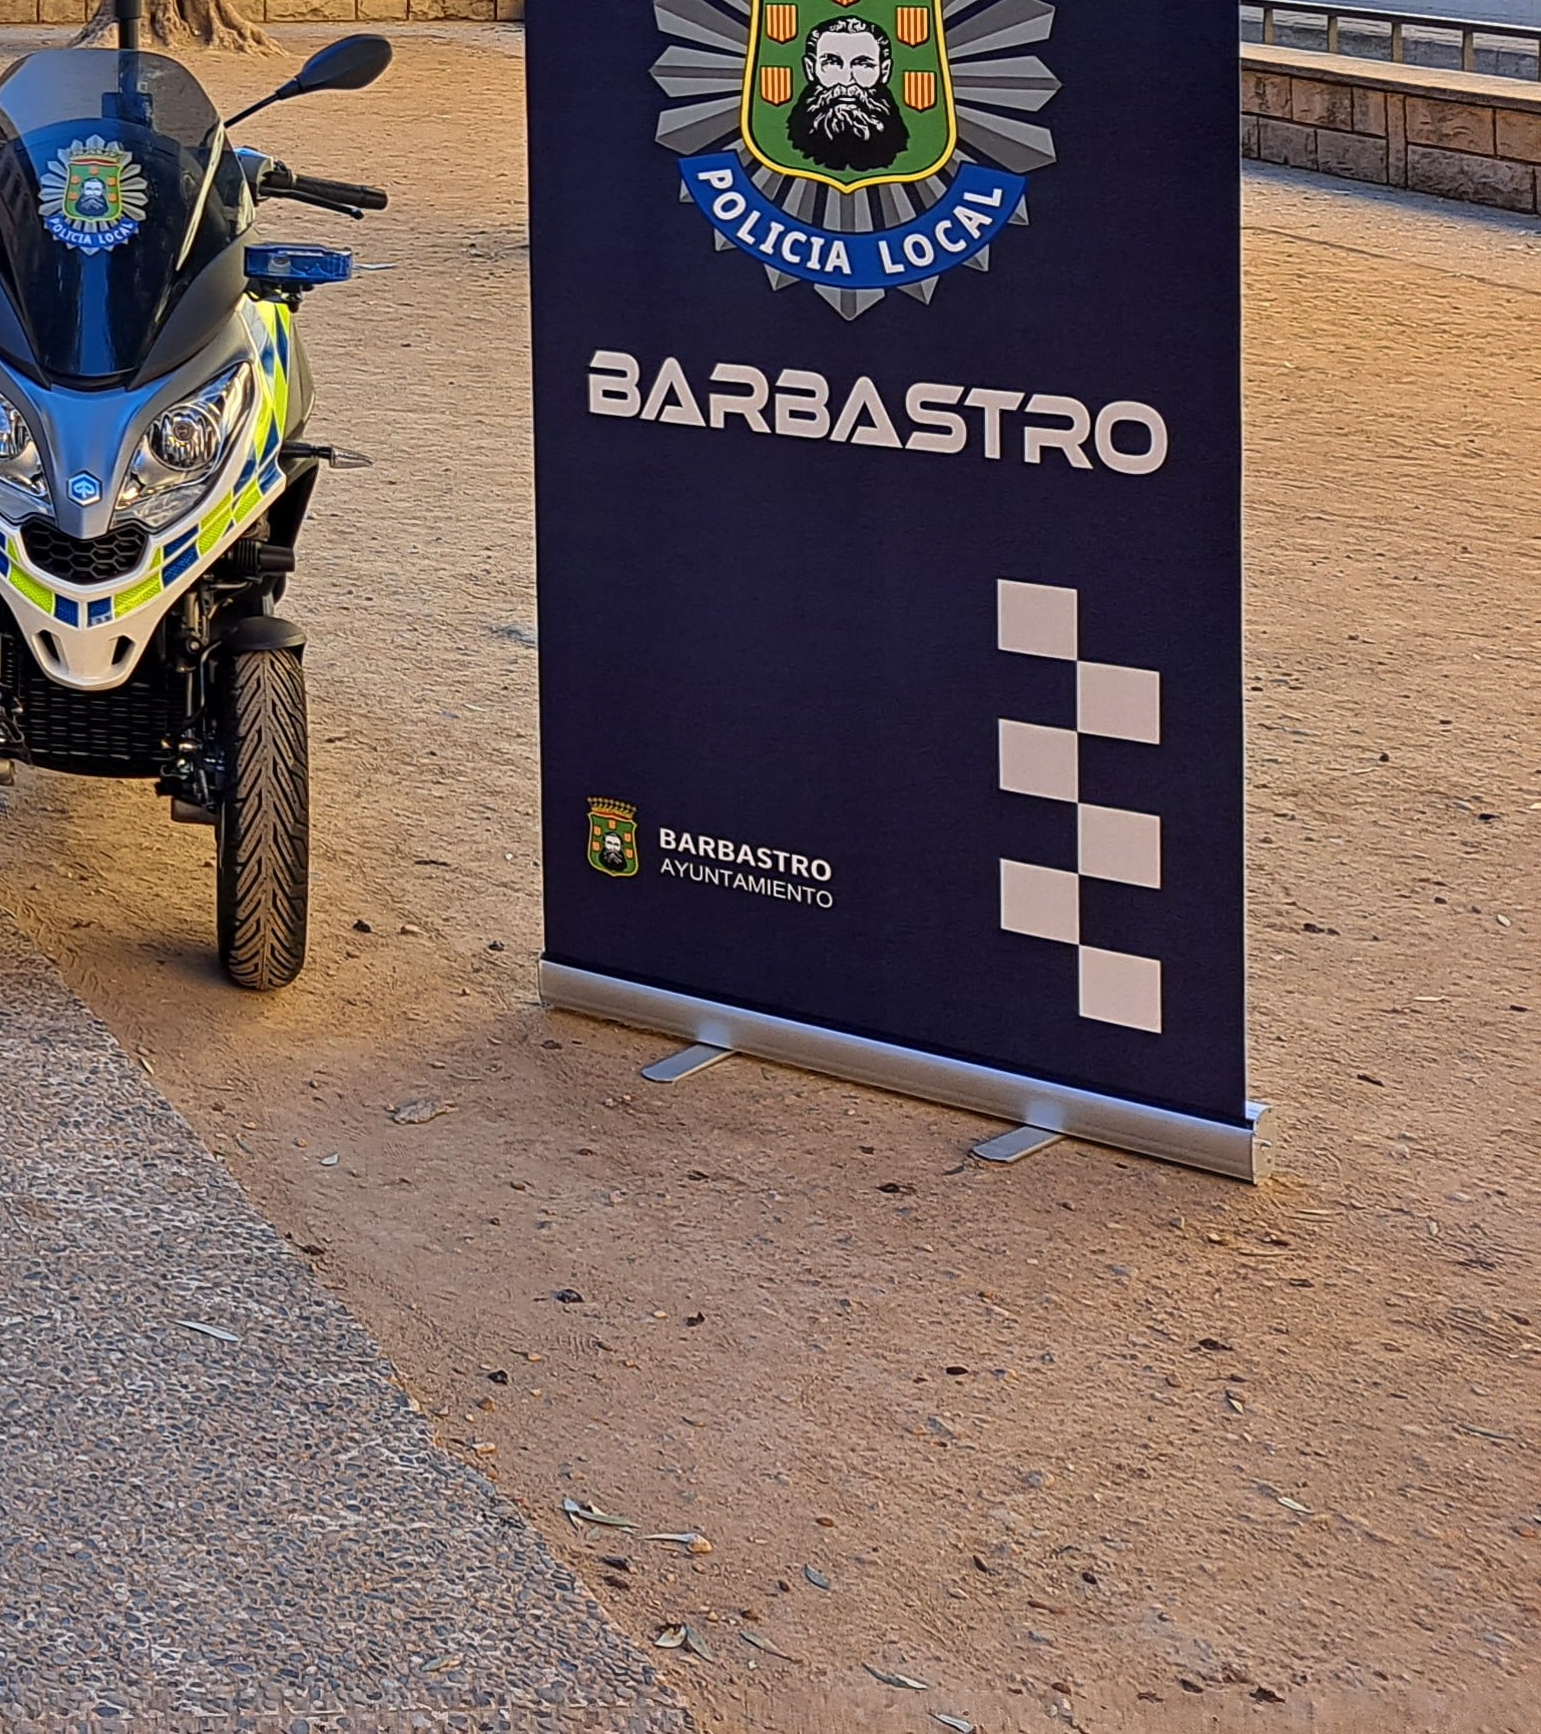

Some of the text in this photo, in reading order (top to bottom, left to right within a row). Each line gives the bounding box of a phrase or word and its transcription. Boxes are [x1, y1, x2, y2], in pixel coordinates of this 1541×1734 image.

[48, 217, 134, 245] POLICIA LOCAL
[698, 169, 1003, 275] POLICIA LOCAL
[587, 349, 1169, 475] BARBASTRO
[659, 827, 833, 882] BARBASTRO
[660, 858, 834, 909] AYUNTAMIENTO
